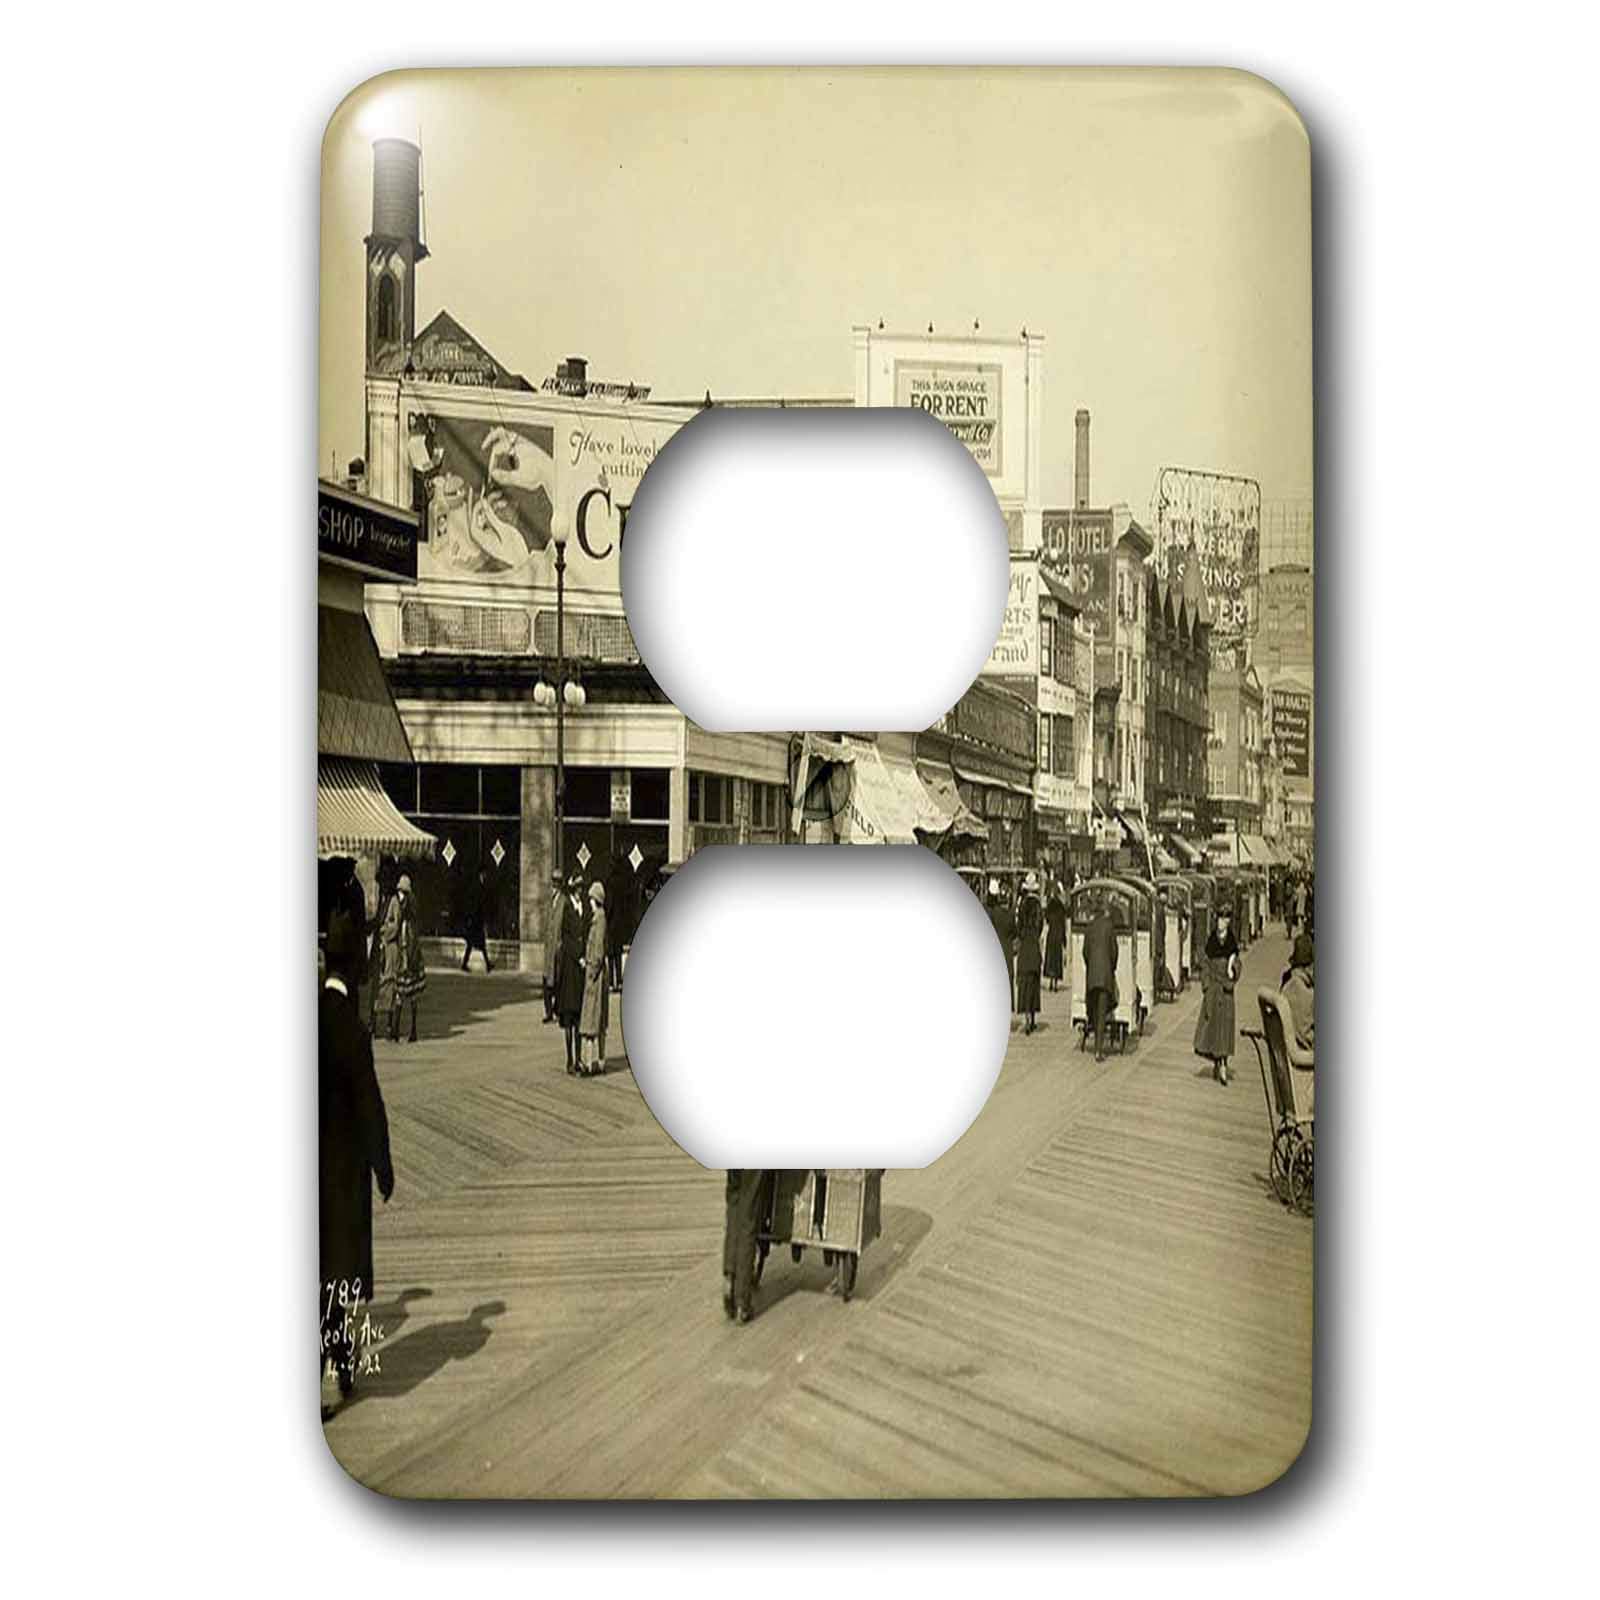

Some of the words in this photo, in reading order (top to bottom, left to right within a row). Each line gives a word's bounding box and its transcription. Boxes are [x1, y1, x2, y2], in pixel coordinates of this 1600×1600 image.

[912, 380, 931, 391] THIS
[957, 381, 987, 393] SPACE
[911, 394, 943, 415] FOR
[945, 395, 988, 416] RENT
[569, 430, 614, 467] Have
[319, 504, 364, 548] SHOP
[1068, 526, 1109, 556] HOTEL
